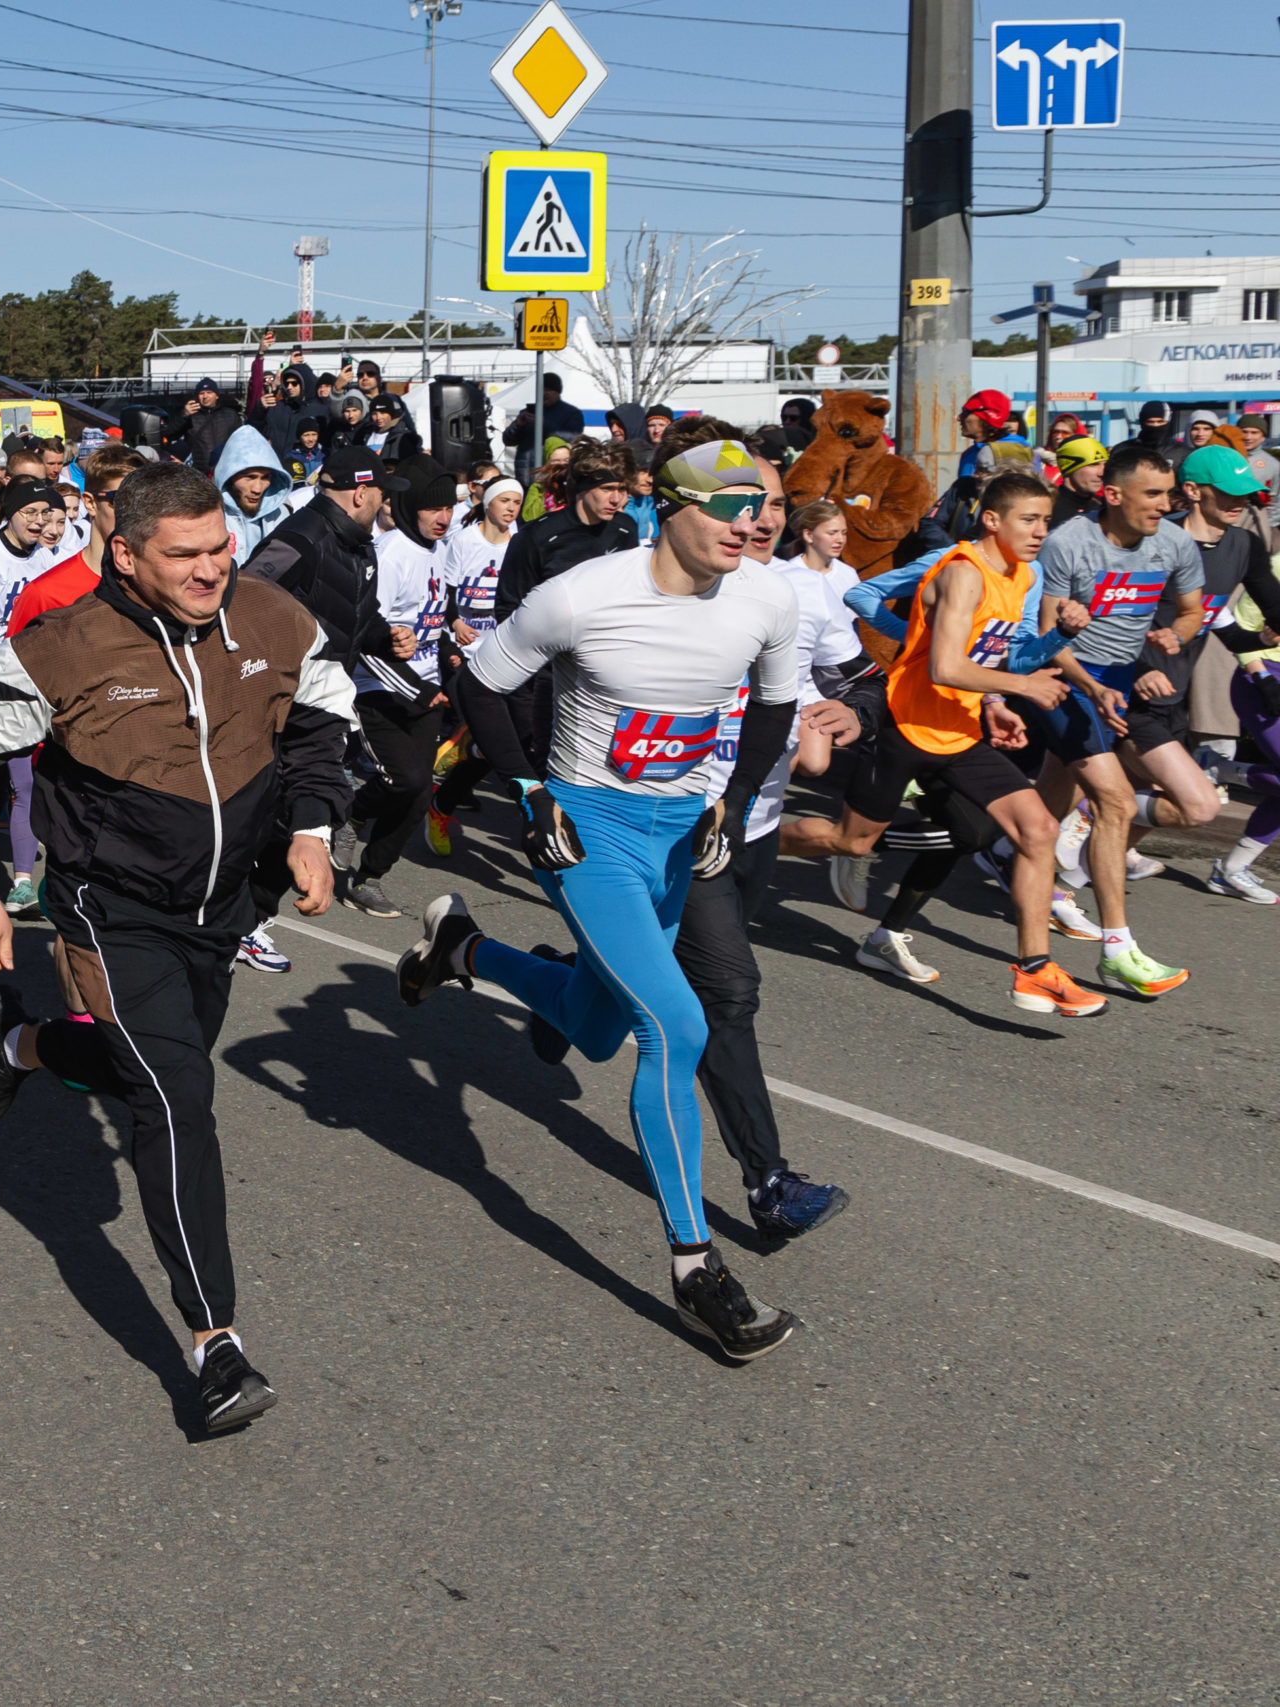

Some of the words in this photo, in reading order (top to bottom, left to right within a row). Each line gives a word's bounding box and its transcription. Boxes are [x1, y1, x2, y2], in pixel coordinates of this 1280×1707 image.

[917, 285, 942, 299] 398
[1225, 372, 1272, 381] имени
[464, 587, 489, 598] 028
[1101, 587, 1138, 602] 594
[240, 658, 268, 680] Anta
[628, 739, 685, 758] 470
